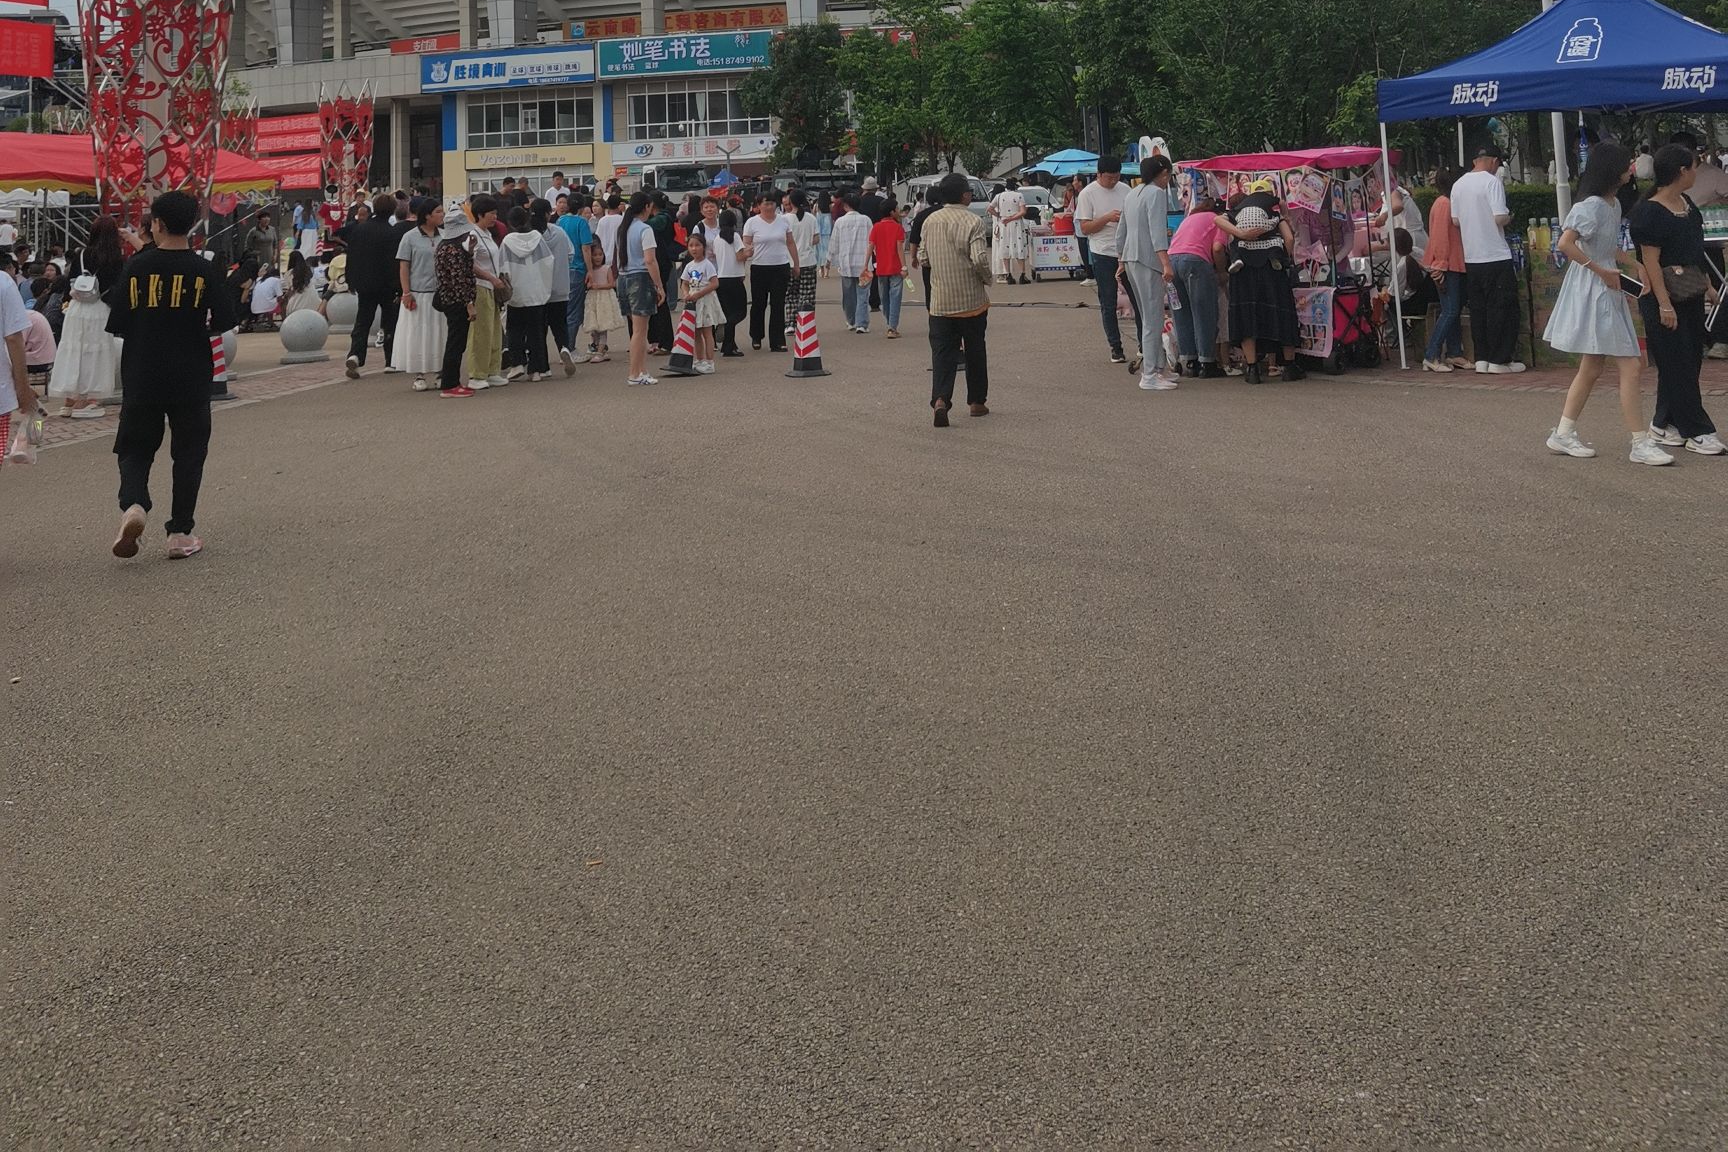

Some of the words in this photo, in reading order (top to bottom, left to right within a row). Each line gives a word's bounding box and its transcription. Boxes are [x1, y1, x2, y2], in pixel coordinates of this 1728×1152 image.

[619, 38, 711, 62] 妙笔书法
[1661, 65, 1718, 93] 脉动
[1450, 80, 1500, 107] 脉动
